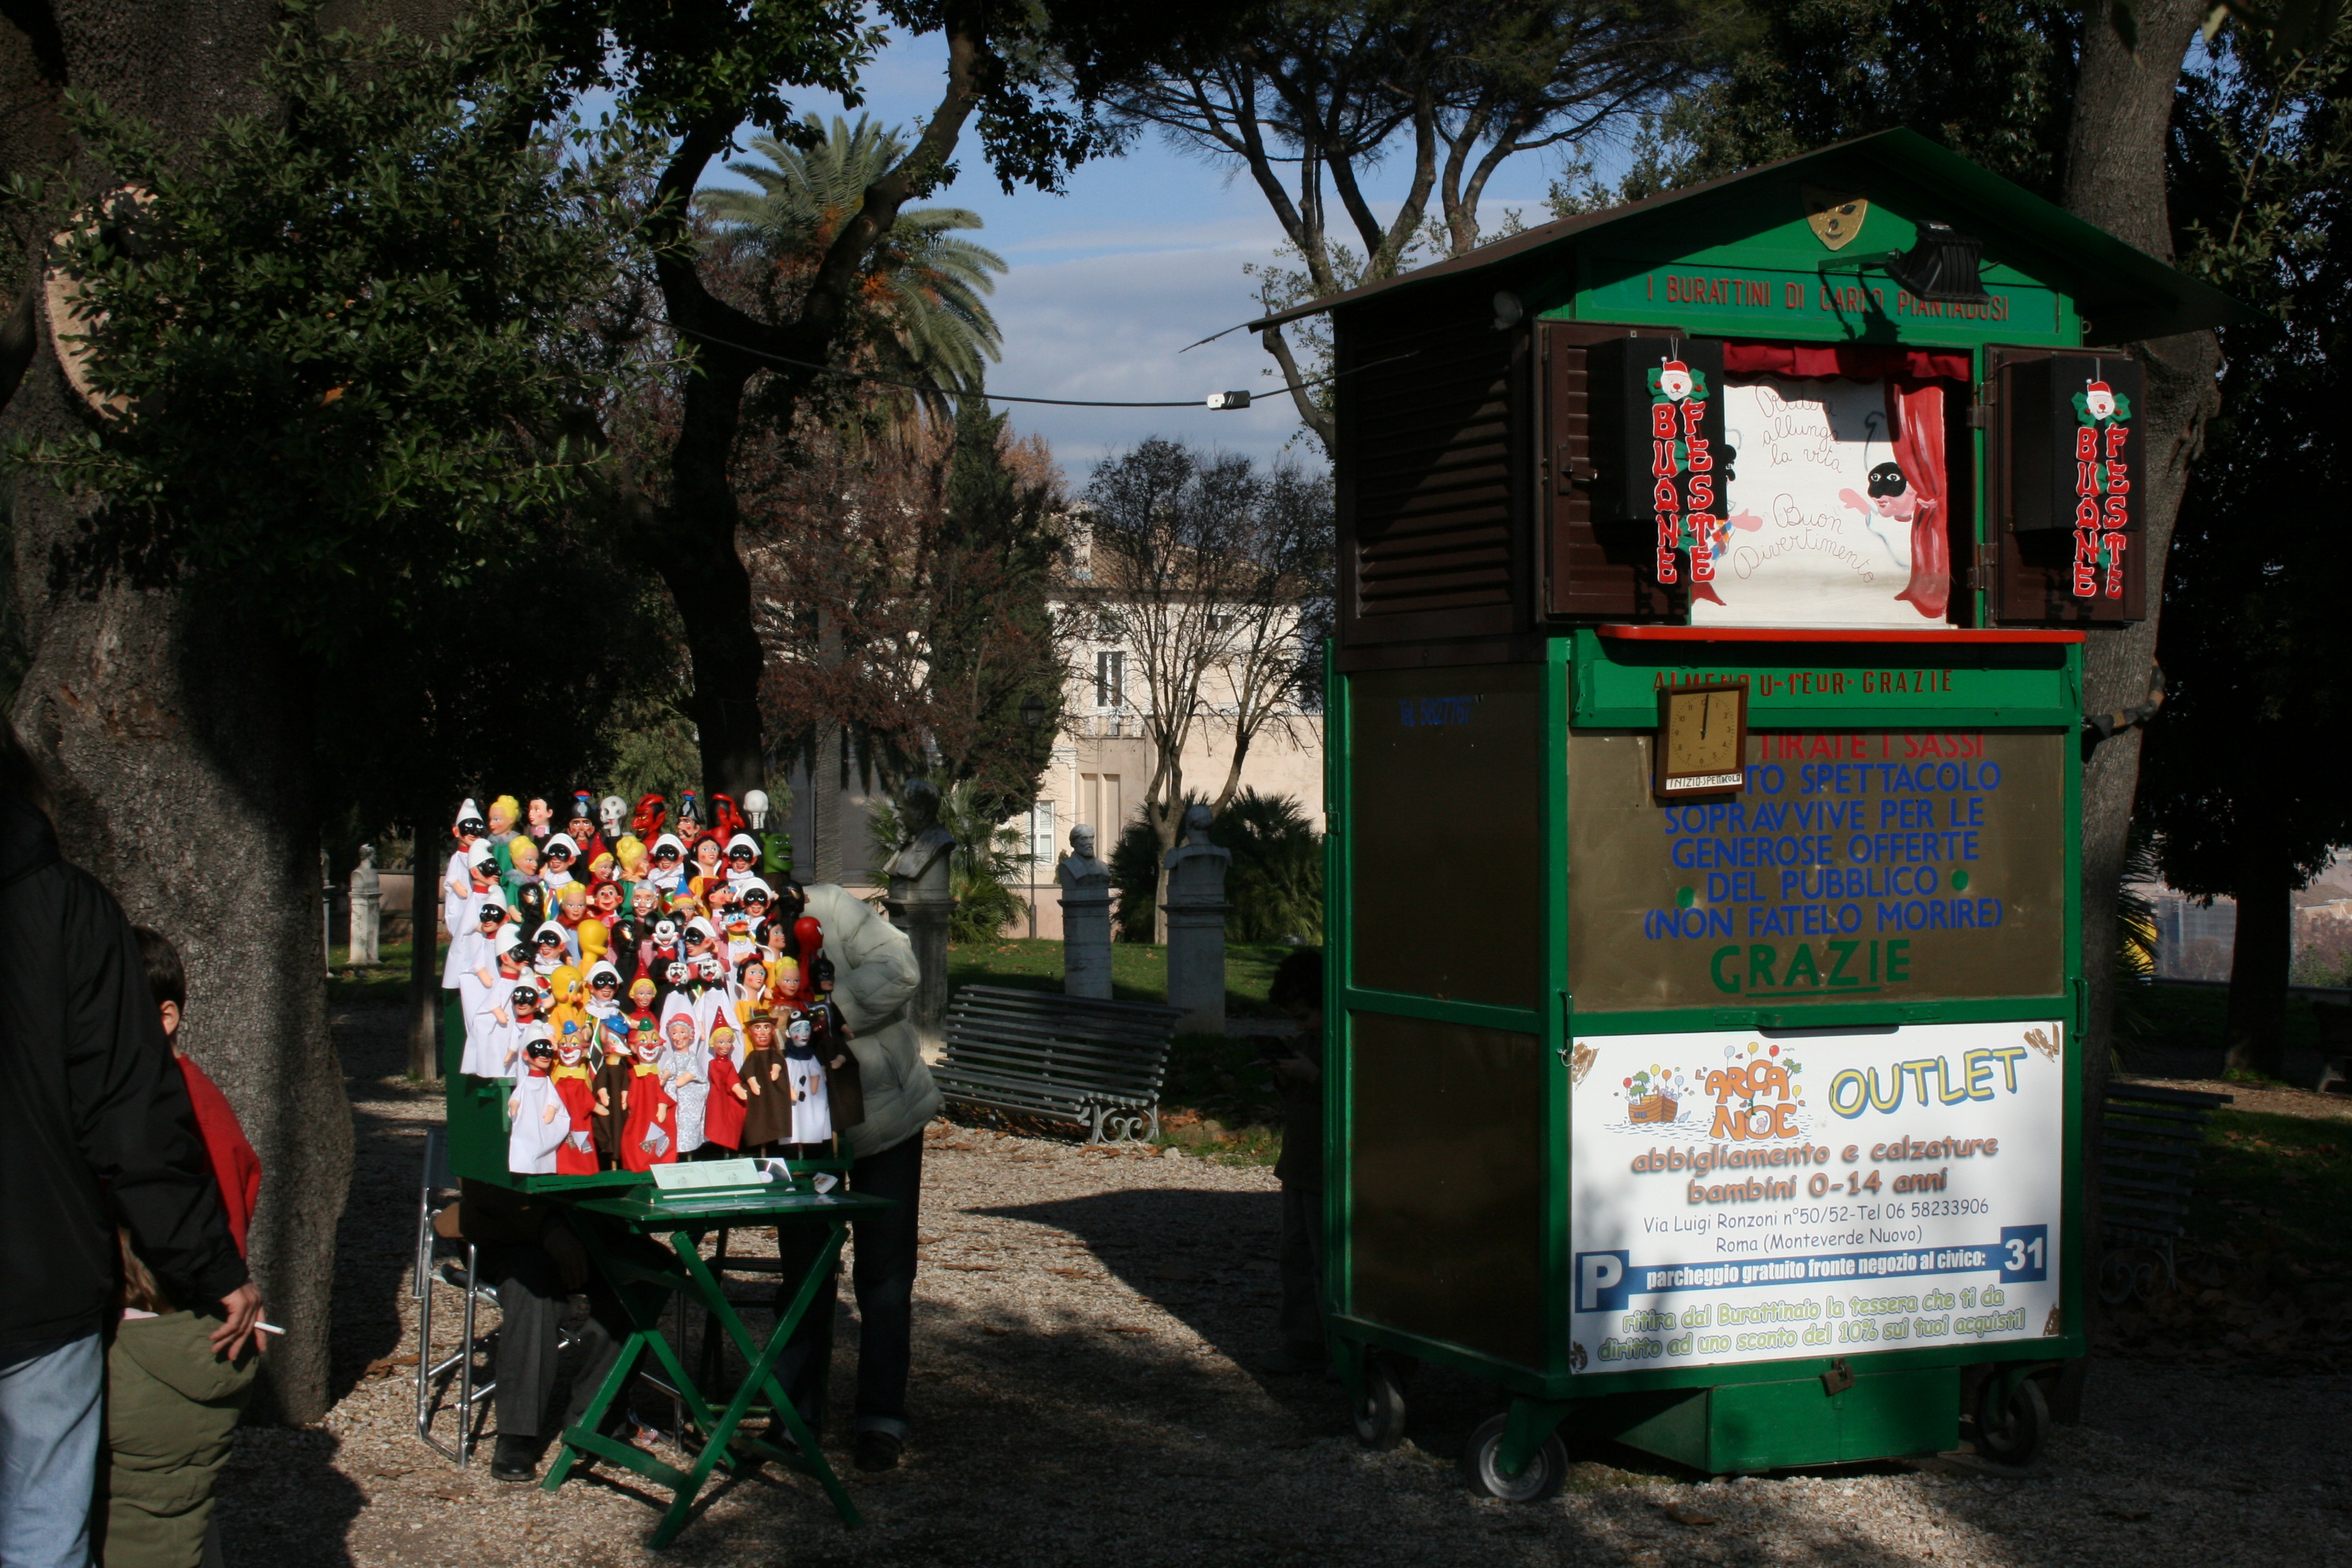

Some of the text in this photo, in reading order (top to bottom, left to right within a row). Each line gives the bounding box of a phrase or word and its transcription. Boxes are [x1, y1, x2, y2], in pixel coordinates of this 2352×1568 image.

[1647, 274, 1653, 301] I
[1667, 275, 1771, 307] BURATTINI
[1785, 282, 1805, 309] DI
[1819, 286, 1884, 313] CARLO
[1763, 415, 1842, 451] allunga
[1770, 444, 1843, 473] la vita
[1652, 403, 1680, 584] BUONE
[1680, 397, 1716, 583] FESTE
[2103, 422, 2131, 599] FESTE
[1773, 494, 1844, 535] Buon
[2073, 426, 2101, 597] BUONE
[1734, 527, 1875, 583] Divertimento
[1863, 669, 1953, 693] GRAZIE
[1800, 760, 2001, 794] SPETTACOLO
[1664, 797, 1984, 835] SOPRAVVIVE PER LE
[1671, 831, 1979, 869] GENEROSE OFFERTE
[1707, 865, 1939, 903] DEL PUBBLICO
[1644, 898, 2003, 940] (NON FATELO MORIRE)
[1710, 939, 1910, 993] GRAZIE
[1828, 1046, 2028, 1119] OUTLET
[1633, 1134, 1999, 1177] abbigliamento e calzature
[1689, 1166, 1949, 1204] bambini 0-14 anni
[1643, 1217, 1668, 1234] Via
[1673, 1214, 1711, 1235] Luigi
[1717, 1210, 1777, 1229] Ronzoni
[1886, 1203, 1906, 1219] 06
[1911, 1197, 1989, 1218] 58233906
[1716, 1224, 1922, 1254] Roma (Monteverde Nuovo)
[1581, 1253, 1623, 1310] P
[1646, 1236, 2043, 1290] parcheggio gratuito fronte negozio al civico: 31
[1623, 1284, 2005, 1333] ritira dal Burattinaio la tessera che ti da
[1598, 1307, 2026, 1362] diritto ad uno sconto del 10% sui tuoi acquisti!
